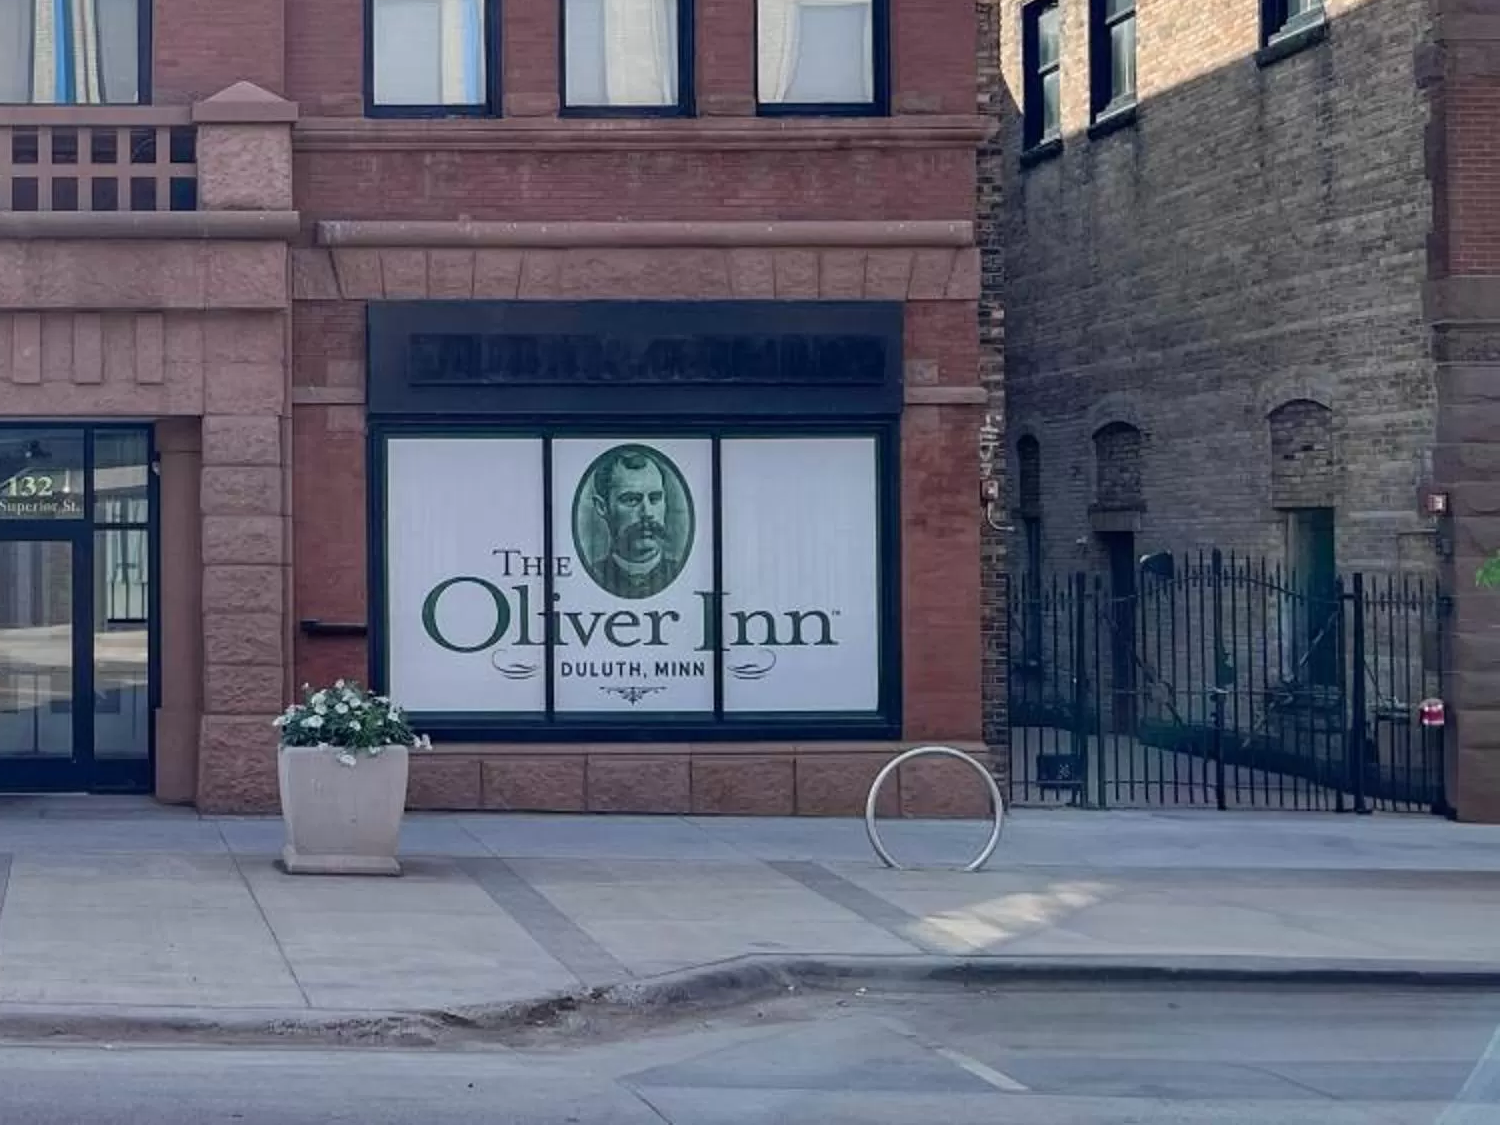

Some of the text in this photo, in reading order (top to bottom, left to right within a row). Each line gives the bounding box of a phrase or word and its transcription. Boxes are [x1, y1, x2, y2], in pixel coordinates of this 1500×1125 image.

[8, 476, 53, 496] 132
[0, 499, 58, 516] Superior
[421, 577, 681, 653] Oliver
[561, 662, 706, 679] DULUTH, MINN
